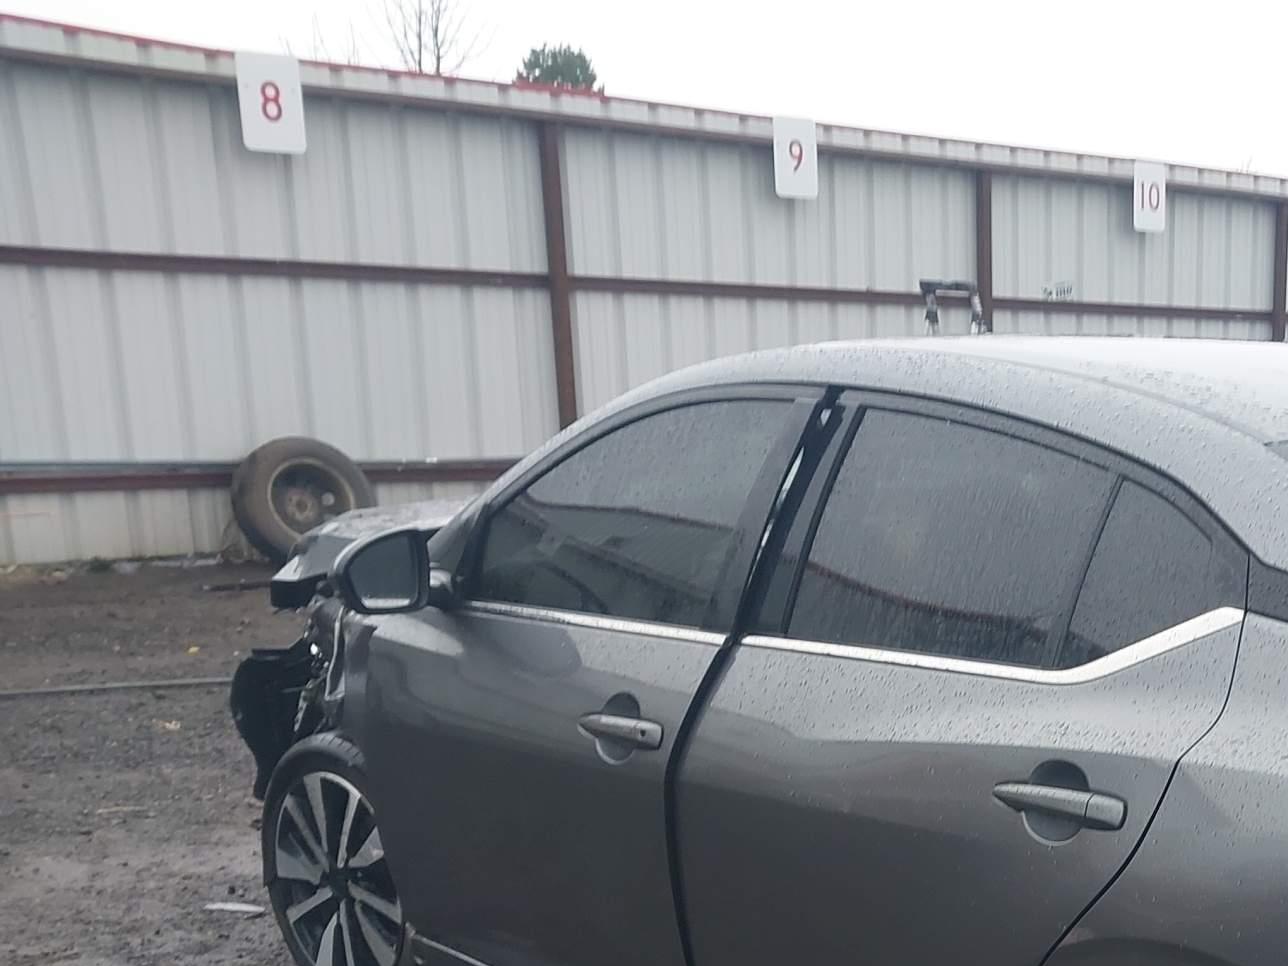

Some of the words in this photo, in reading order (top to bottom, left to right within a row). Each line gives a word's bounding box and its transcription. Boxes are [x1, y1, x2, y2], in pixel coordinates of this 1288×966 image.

[260, 80, 283, 122] 8
[788, 137, 804, 173] 9
[1140, 180, 1161, 213] 10
